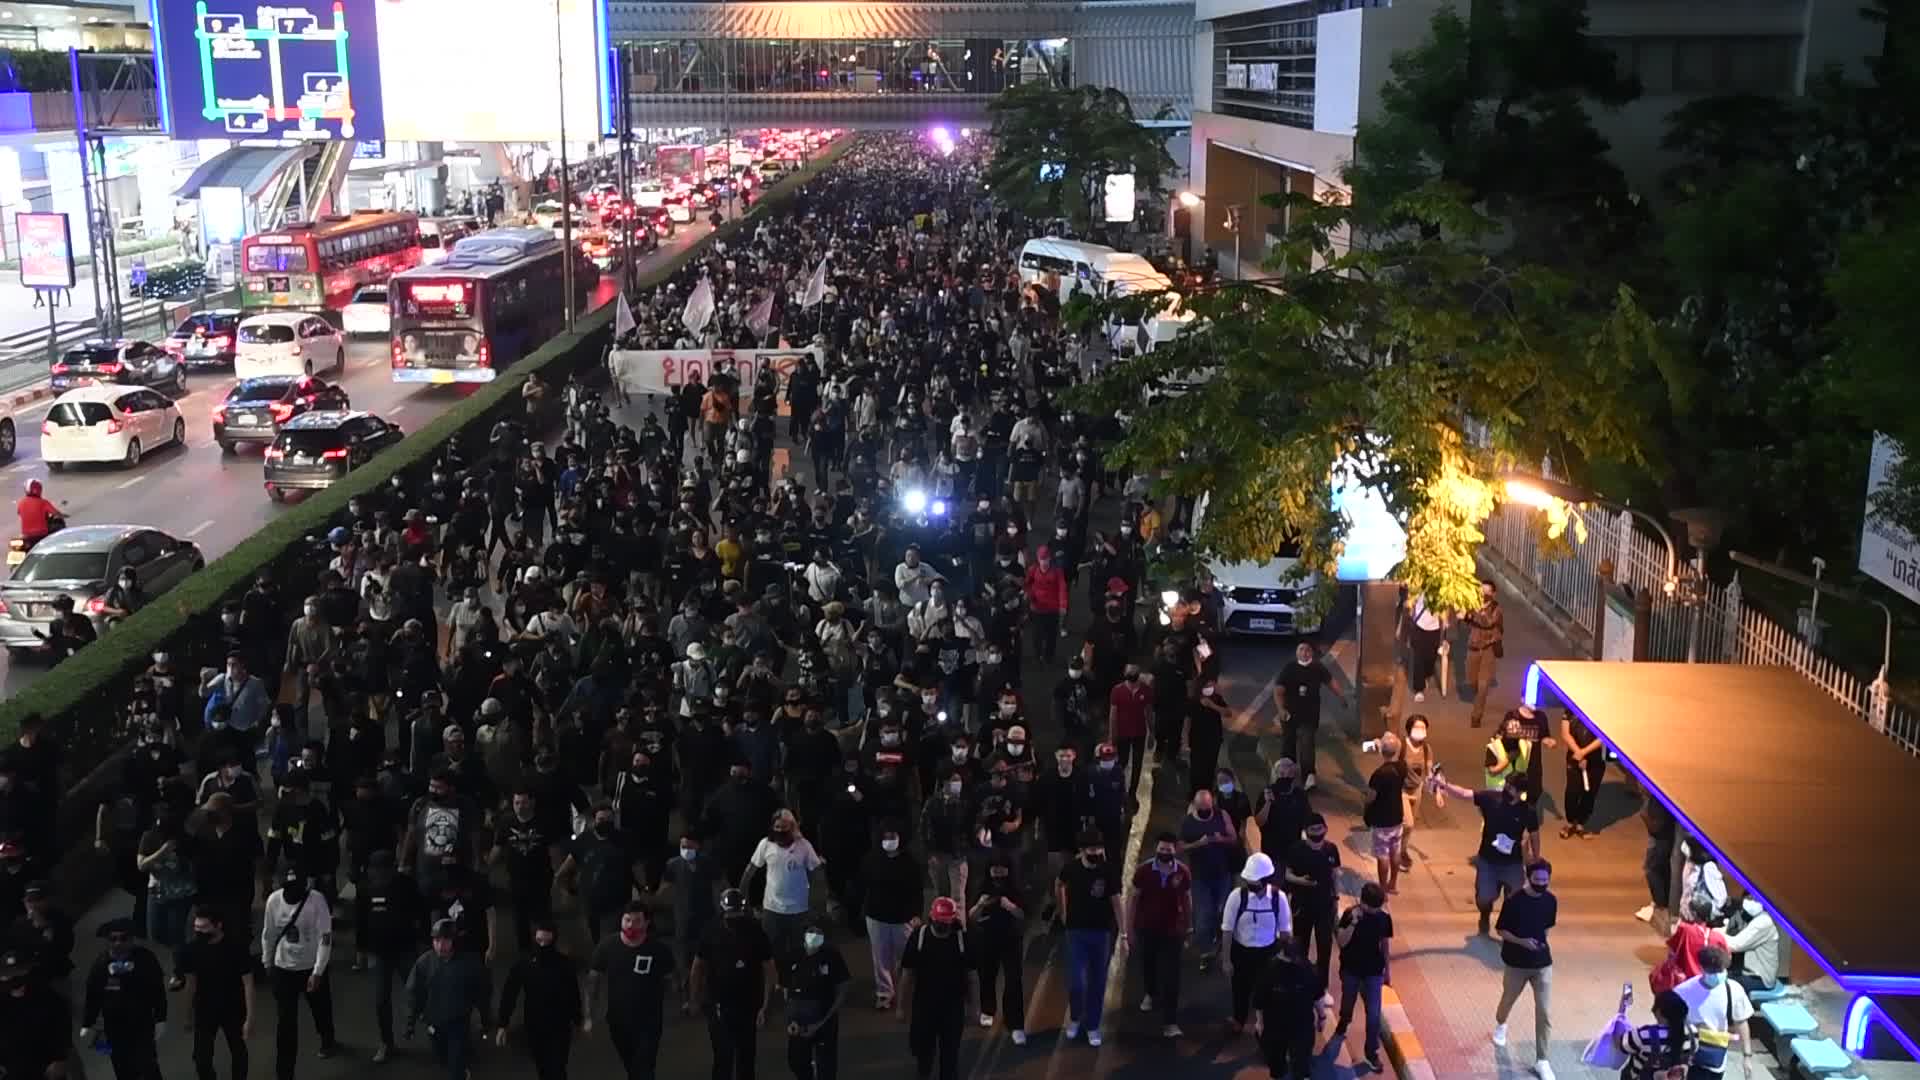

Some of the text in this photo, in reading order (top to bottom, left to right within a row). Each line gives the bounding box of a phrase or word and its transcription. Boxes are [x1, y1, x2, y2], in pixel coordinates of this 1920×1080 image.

[283, 20, 295, 32] 7
[315, 78, 328, 91] 4
[233, 114, 246, 128] 4
